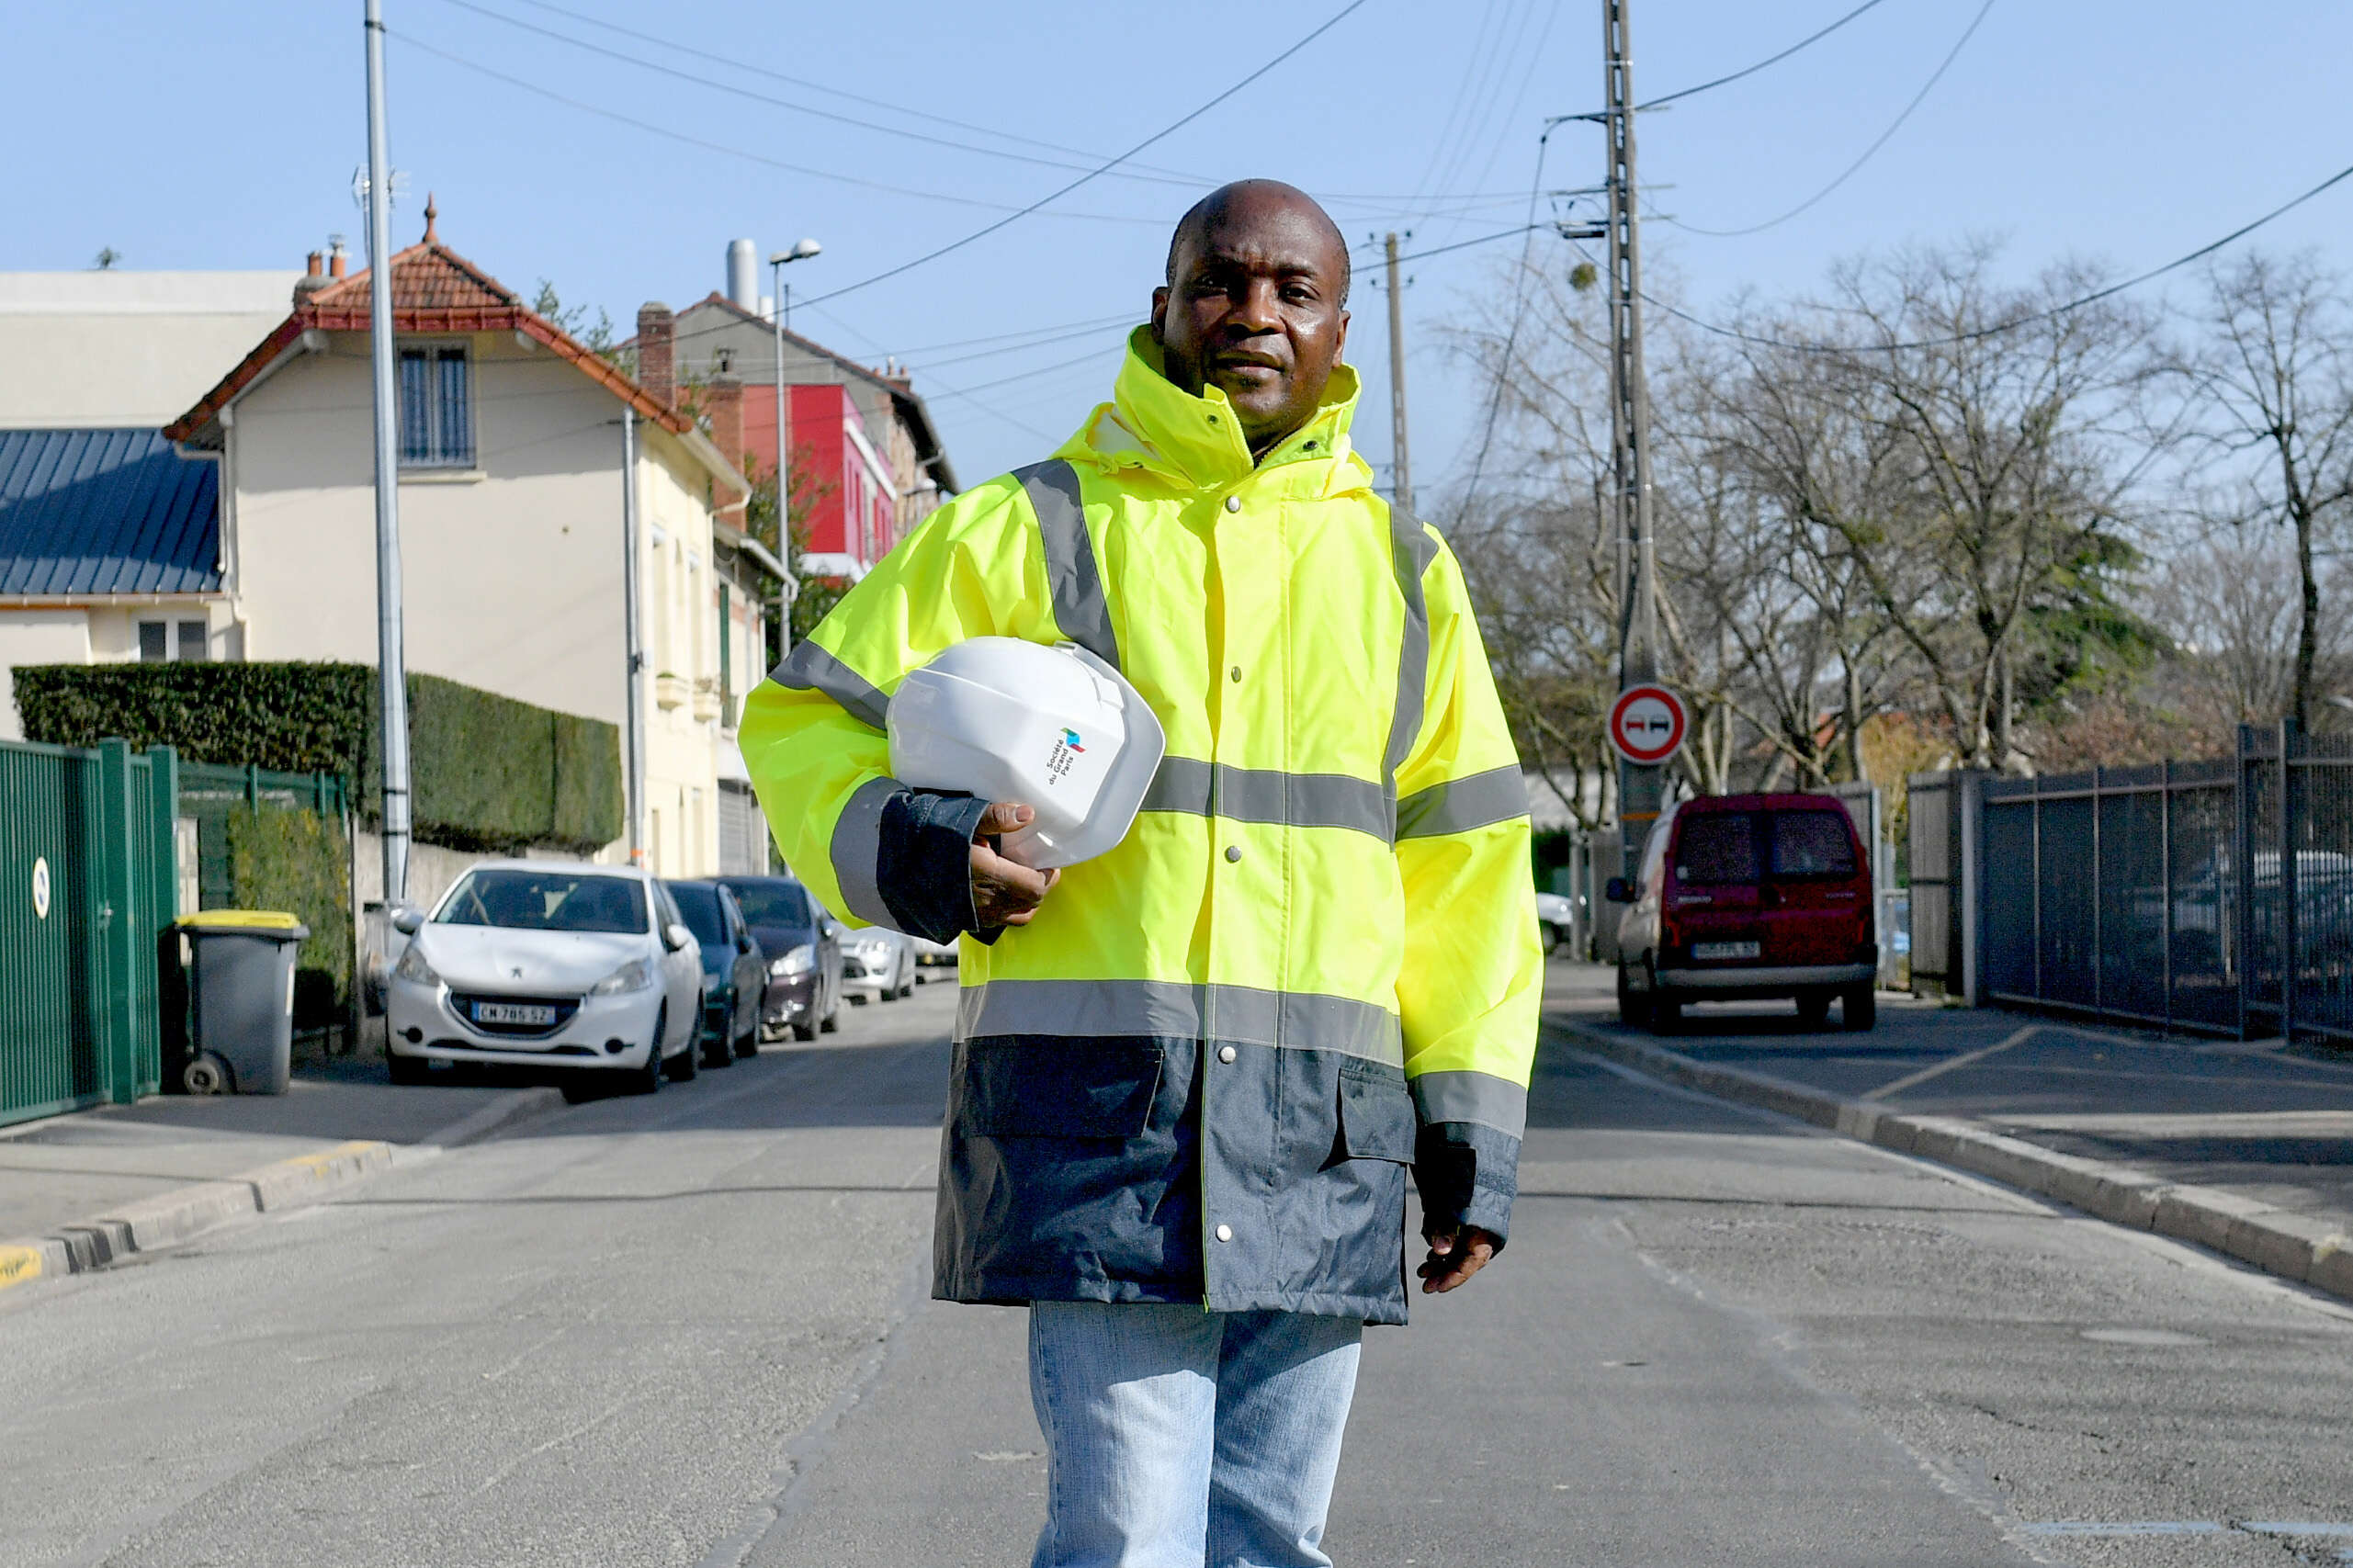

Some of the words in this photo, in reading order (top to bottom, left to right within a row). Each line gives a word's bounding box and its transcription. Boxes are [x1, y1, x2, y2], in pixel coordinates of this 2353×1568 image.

[1046, 739, 1064, 769] Société
[1048, 773, 1058, 785] du
[1054, 748, 1069, 773] Grand
[1060, 756, 1074, 776] Paris
